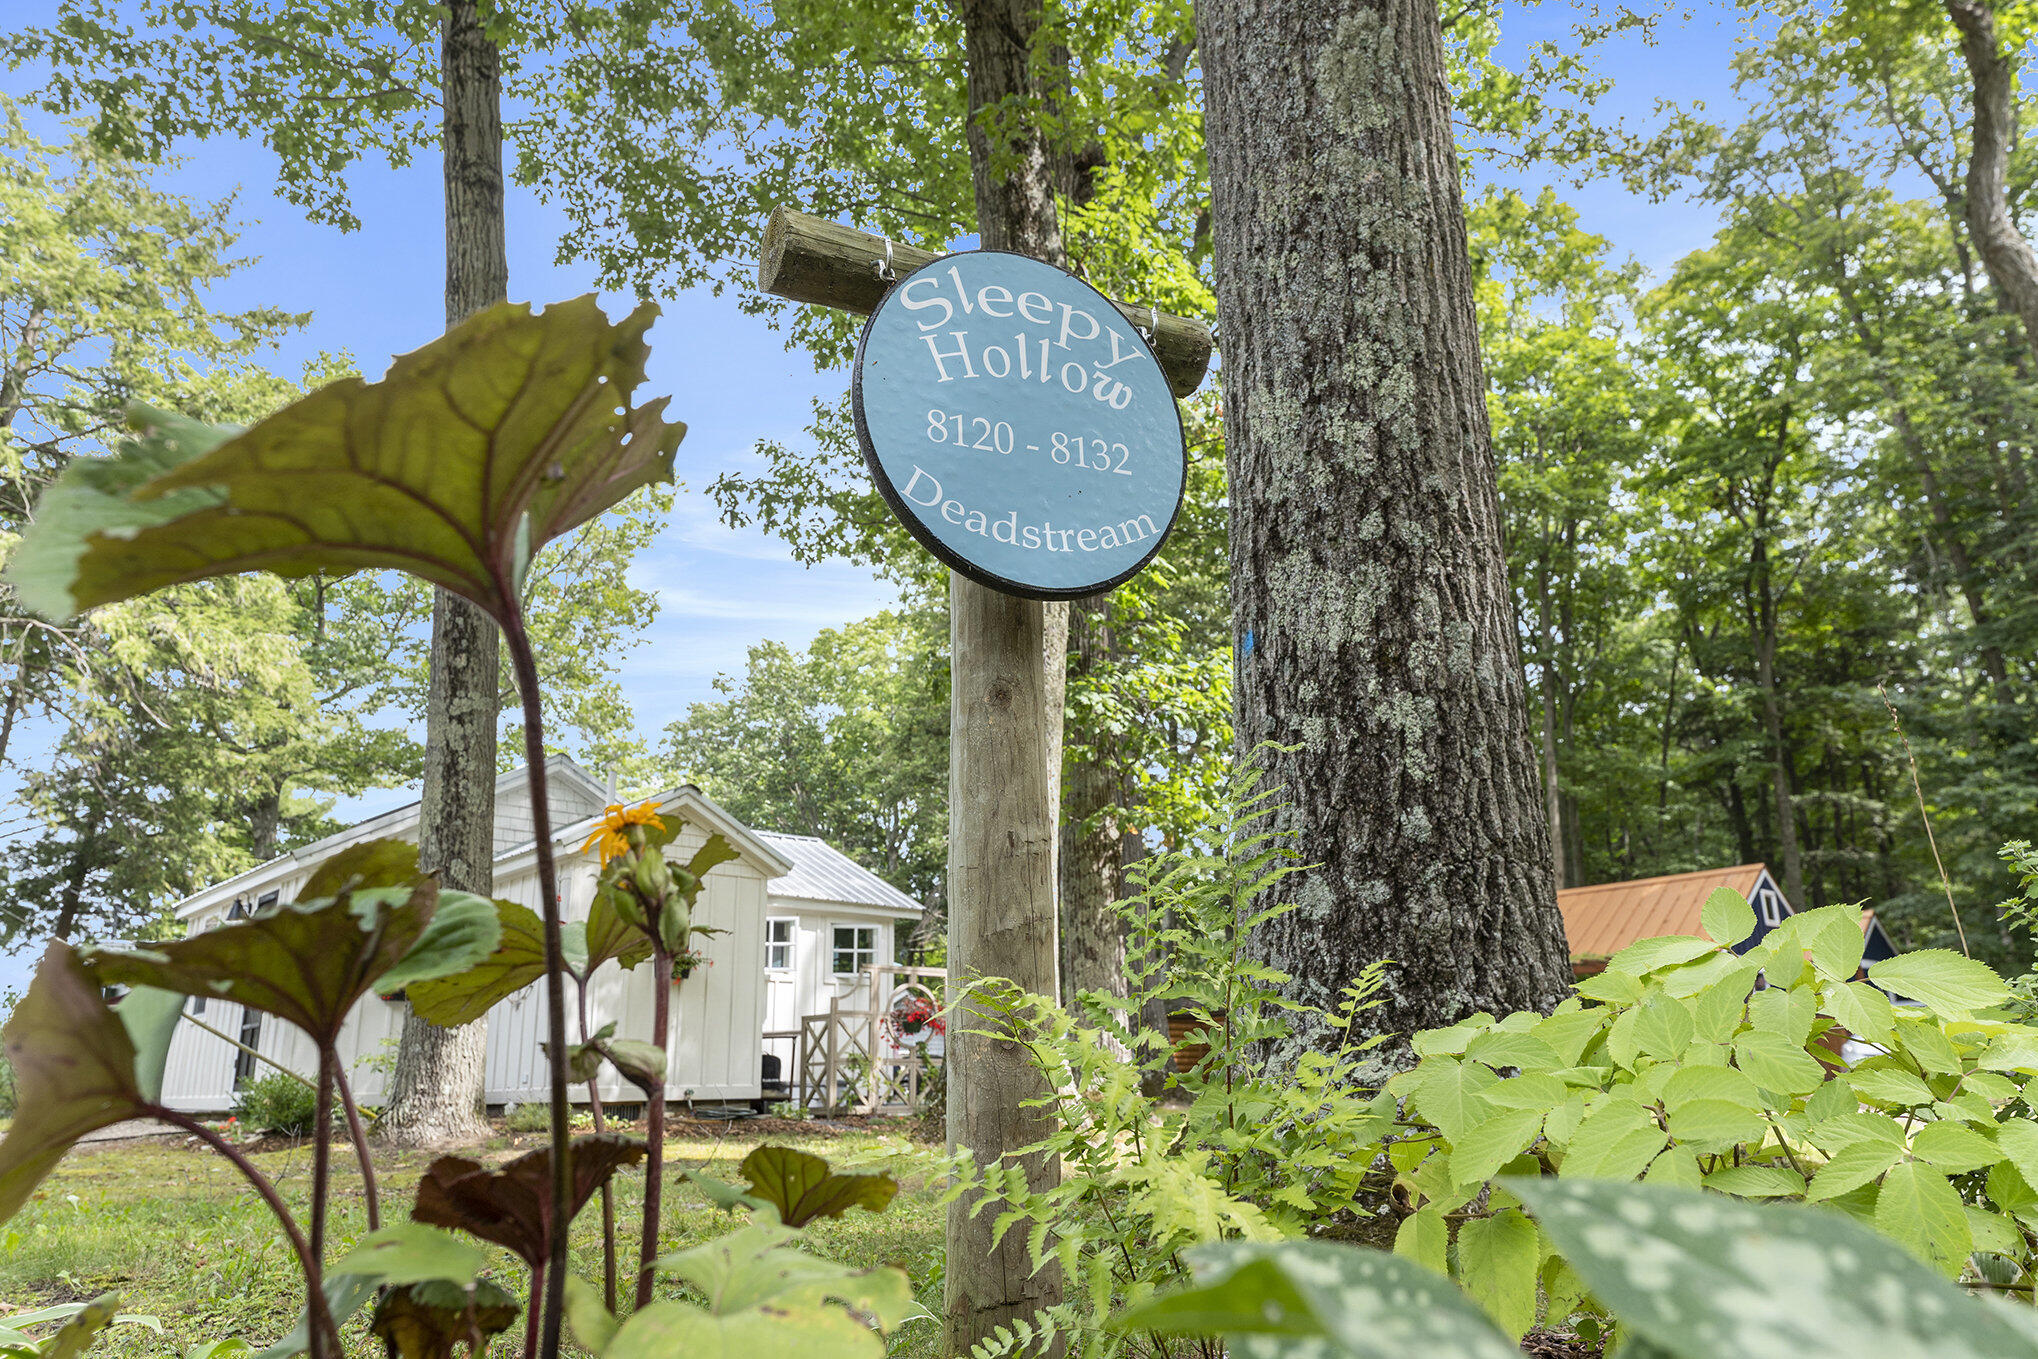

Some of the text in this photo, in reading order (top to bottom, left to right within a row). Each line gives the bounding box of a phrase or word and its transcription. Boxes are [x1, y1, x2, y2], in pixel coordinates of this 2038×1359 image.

[900, 265, 1146, 369] Sleepy
[919, 331, 1133, 410] Hollow
[926, 409, 1014, 455] 8120
[1050, 431, 1133, 476] 8132
[900, 464, 1161, 552] Deadstream
